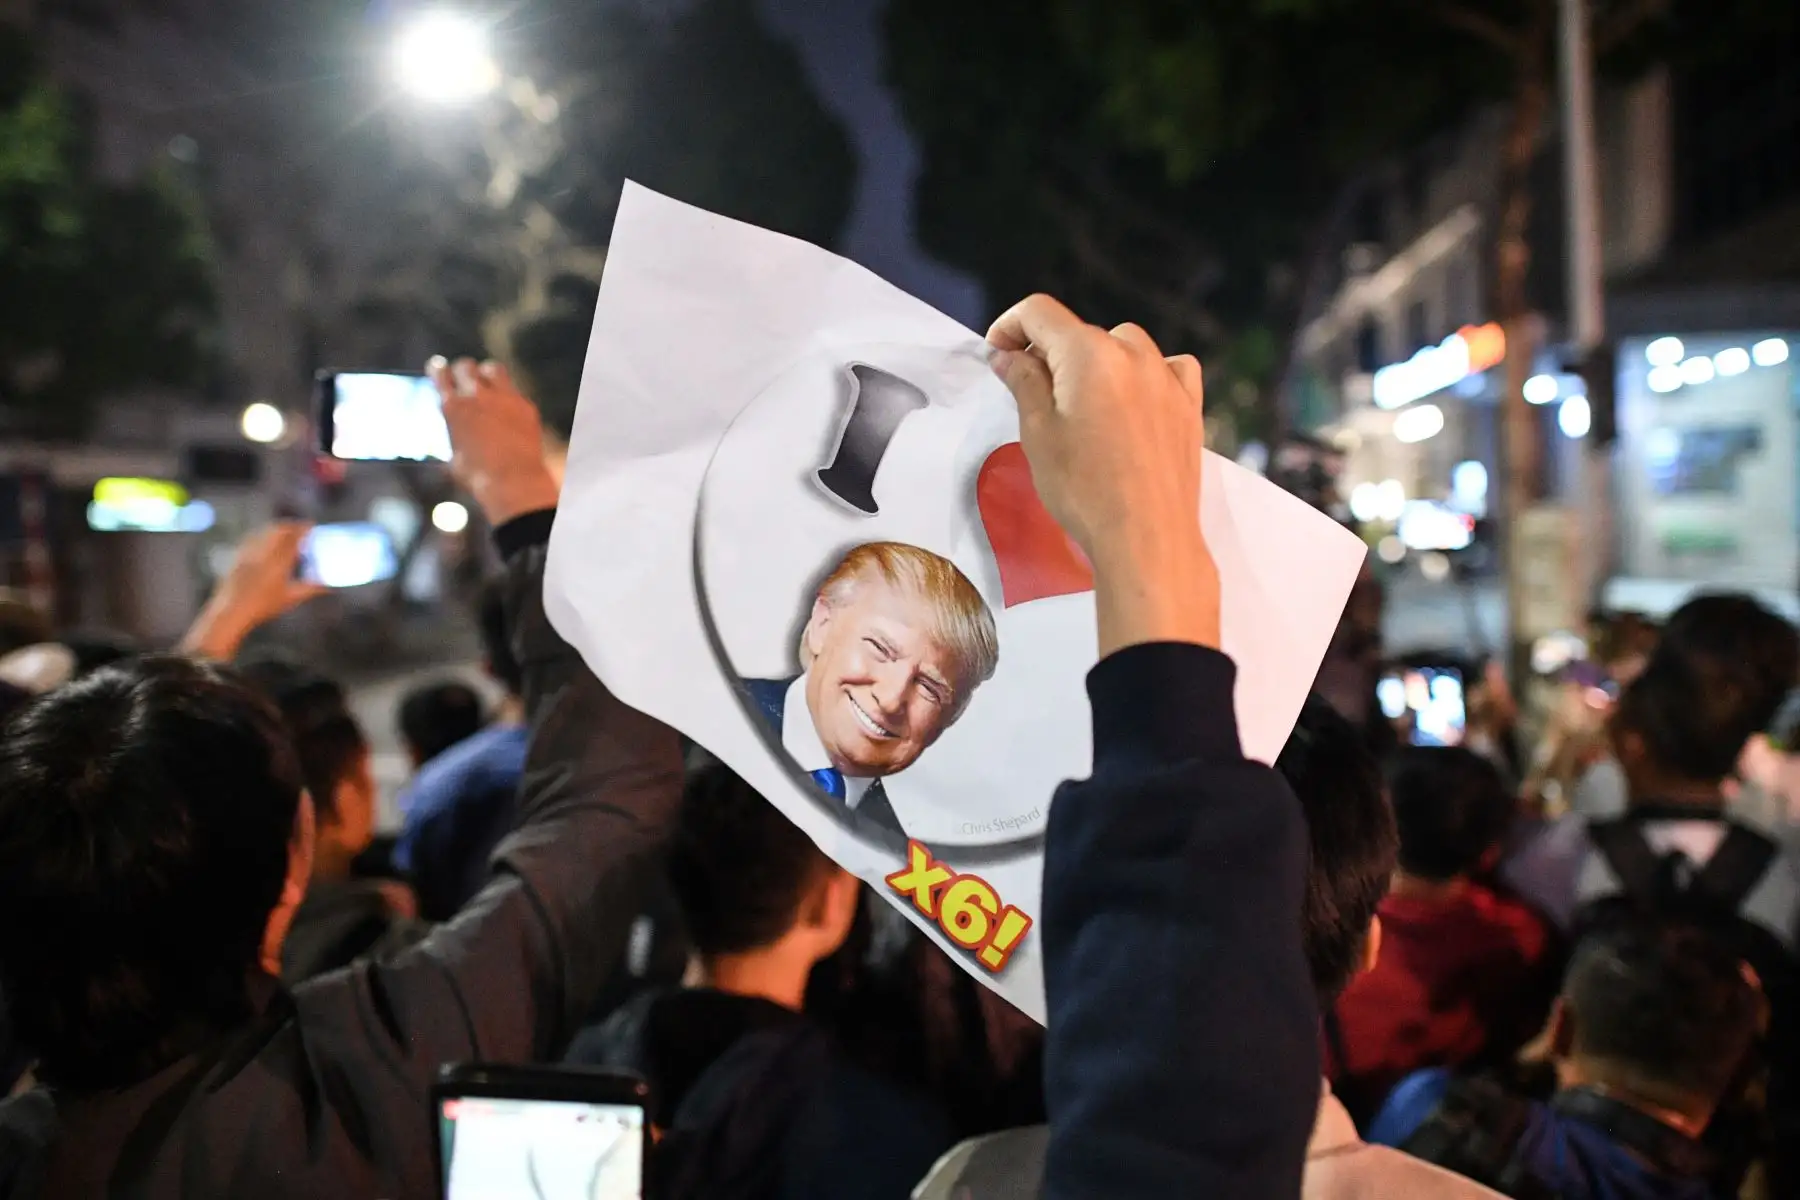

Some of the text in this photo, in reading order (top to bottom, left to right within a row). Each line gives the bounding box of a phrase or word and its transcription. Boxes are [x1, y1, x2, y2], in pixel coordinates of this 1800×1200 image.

[812, 361, 930, 517] I
[962, 807, 1041, 835] Chris Shepard
